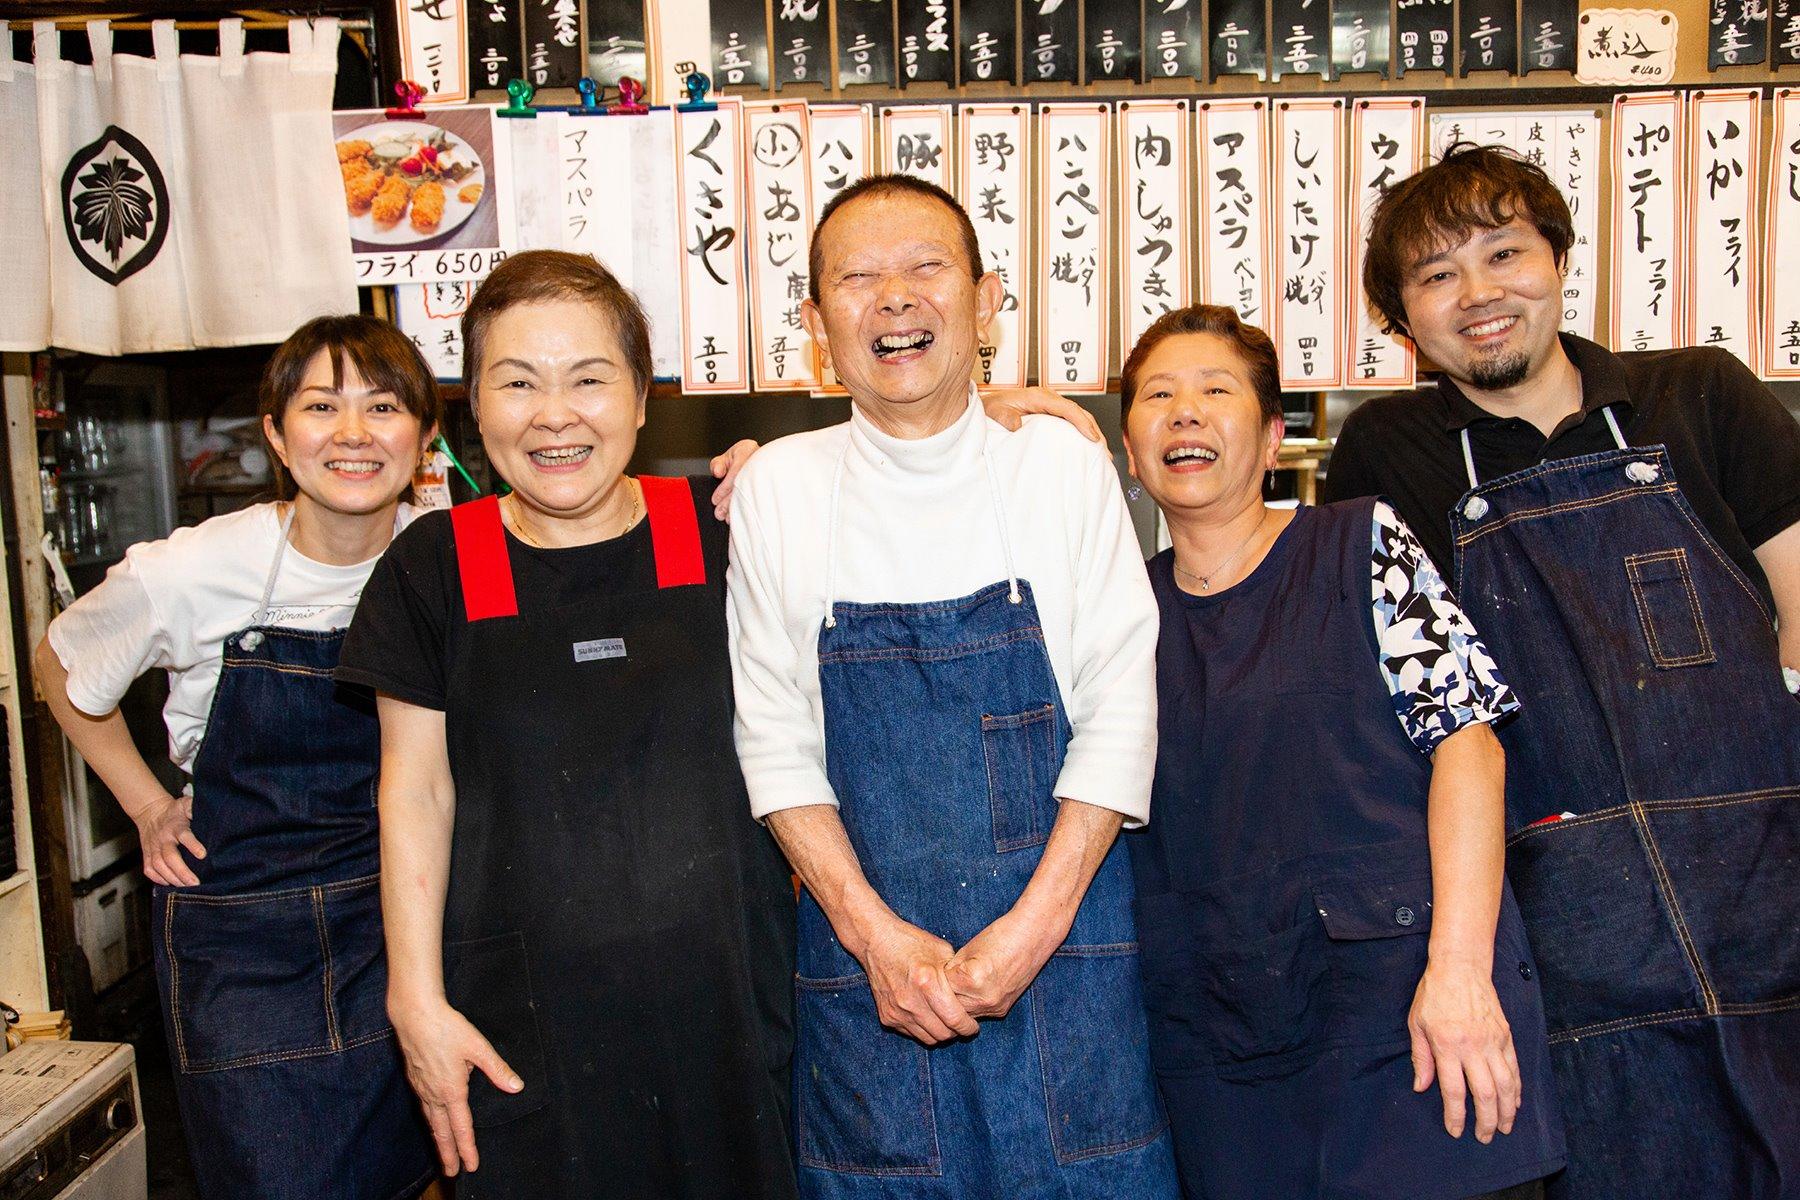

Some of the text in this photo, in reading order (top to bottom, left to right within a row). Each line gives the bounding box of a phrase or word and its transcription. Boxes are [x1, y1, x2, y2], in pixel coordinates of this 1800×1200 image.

[1587, 26, 1667, 60] 煮込
[896, 132, 942, 172] 豚
[1055, 134, 1099, 239] ハンペン
[1566, 123, 1586, 217] やきとり
[687, 118, 736, 286] くさや
[1291, 130, 1321, 269] しいたけ
[356, 253, 418, 278] フライ
